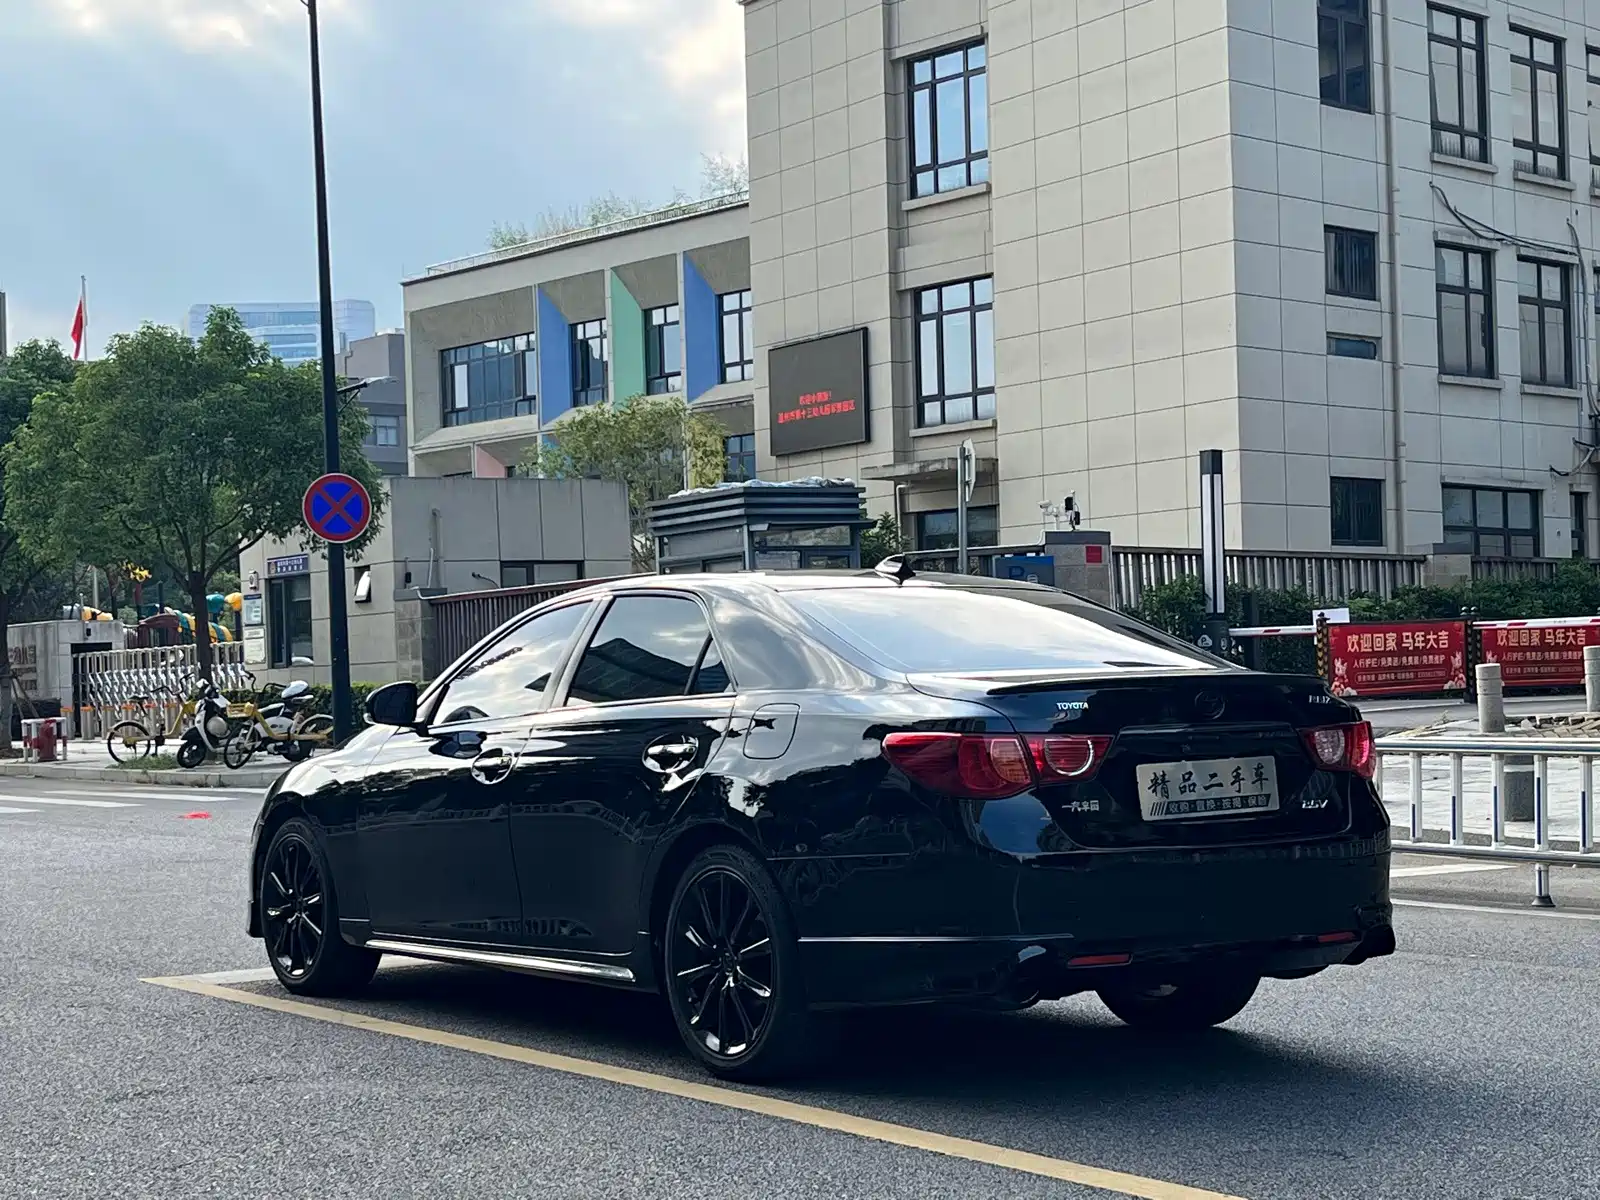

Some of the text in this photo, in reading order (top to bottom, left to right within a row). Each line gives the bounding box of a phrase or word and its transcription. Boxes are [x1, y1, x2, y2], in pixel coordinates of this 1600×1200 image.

[1347, 630, 1449, 653] 欢迎回家 马年大吉
[1497, 628, 1586, 647] 欢迎回家 马年大吉
[1056, 701, 1089, 710] TOYOTA
[1147, 762, 1269, 799] 精品二手车
